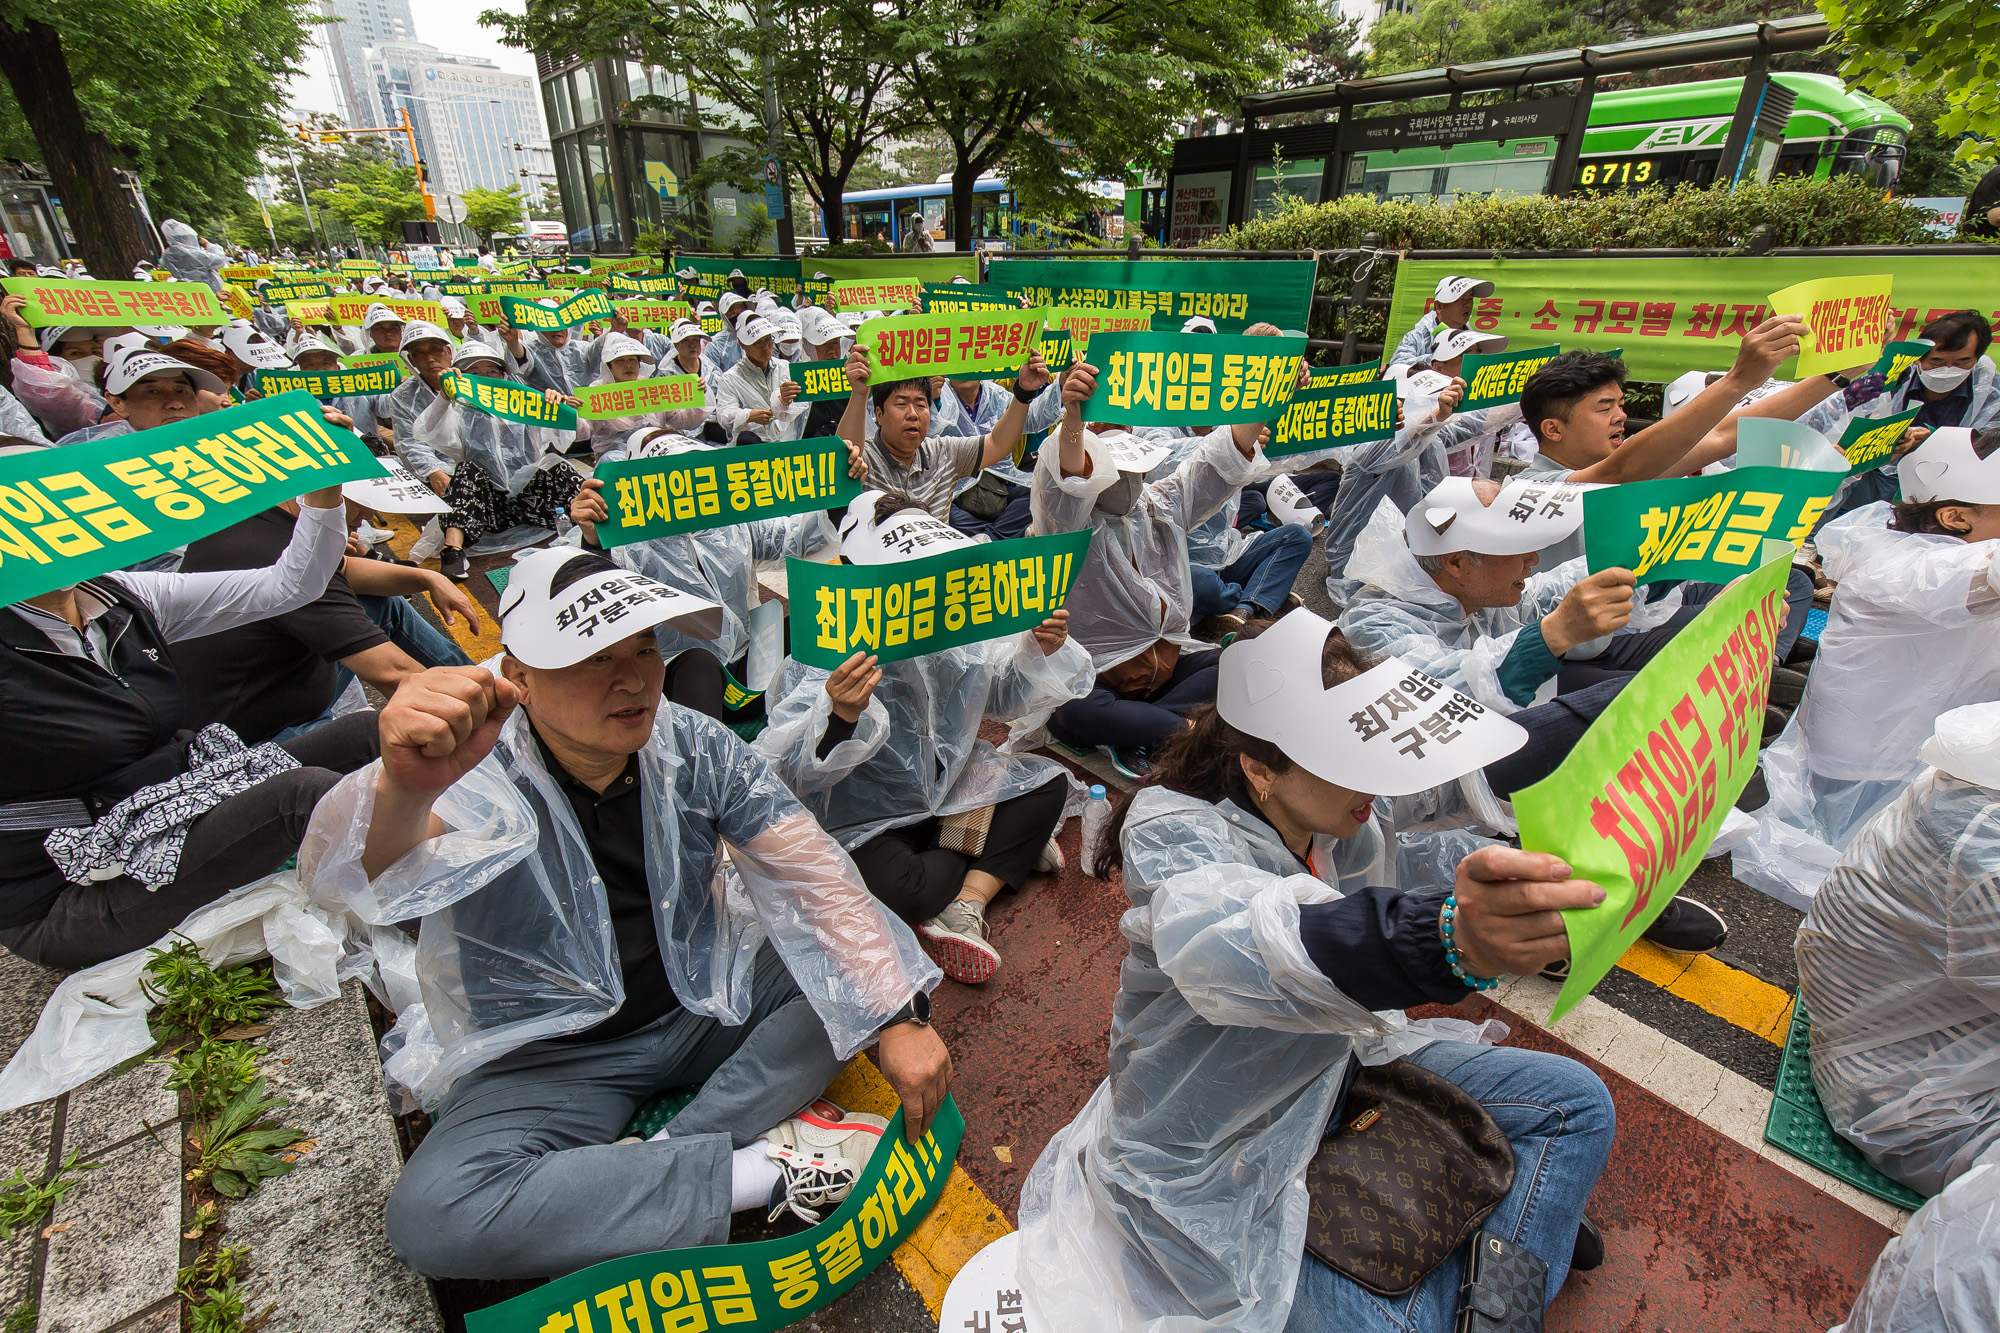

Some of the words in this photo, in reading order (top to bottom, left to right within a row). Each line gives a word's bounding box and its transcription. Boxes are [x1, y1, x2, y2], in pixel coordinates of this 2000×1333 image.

[1503, 113, 1538, 127] 국회의사당
[1653, 123, 1713, 148] EV
[1580, 160, 1653, 186] 6713
[34, 286, 122, 317] 최저임금
[117, 290, 213, 318] 구분적용!!
[611, 275, 641, 292] 최저임금
[640, 276, 676, 293] 동결하라!!
[837, 286, 878, 307] 최저임금
[1113, 289, 1173, 317] 지불능력
[1178, 291, 1249, 320] 고려하라
[513, 302, 560, 328] 최저임금
[557, 293, 613, 327] 동결하라!!
[1573, 299, 1677, 337] 규모별
[1810, 297, 1852, 355] 최저임금
[1849, 293, 1891, 350] 구분적용!!
[876, 328, 950, 368] 최저임금
[957, 320, 1039, 362] 구분적용!!
[326, 369, 396, 396] 동결하라!!
[589, 388, 635, 414] 최저임금
[638, 381, 694, 407] 구분적용!!
[1106, 350, 1213, 411] 최저임금
[1468, 361, 1517, 402] 최저임금
[476, 384, 559, 422] 동결하라!!
[1331, 392, 1394, 438] 동결하라!!
[104, 410, 352, 520] 동결하라!!
[616, 465, 721, 529] 최저임금
[725, 451, 837, 512] 동결하라!!
[880, 518, 950, 550] 최저임금
[896, 528, 967, 556] 구분적용
[1632, 490, 1784, 578] 최저임금
[554, 573, 656, 633] 최저임금
[575, 585, 681, 640] 구분적용
[815, 575, 937, 655] 최저임금
[943, 552, 1074, 632] 동결하라!!
[1347, 668, 1445, 743] 최저임금
[1390, 691, 1487, 761] 구분적용
[1589, 692, 1719, 932] 최저임금
[1696, 588, 1779, 781] 구분적용!!
[771, 1130, 942, 1310] 동결하라!!
